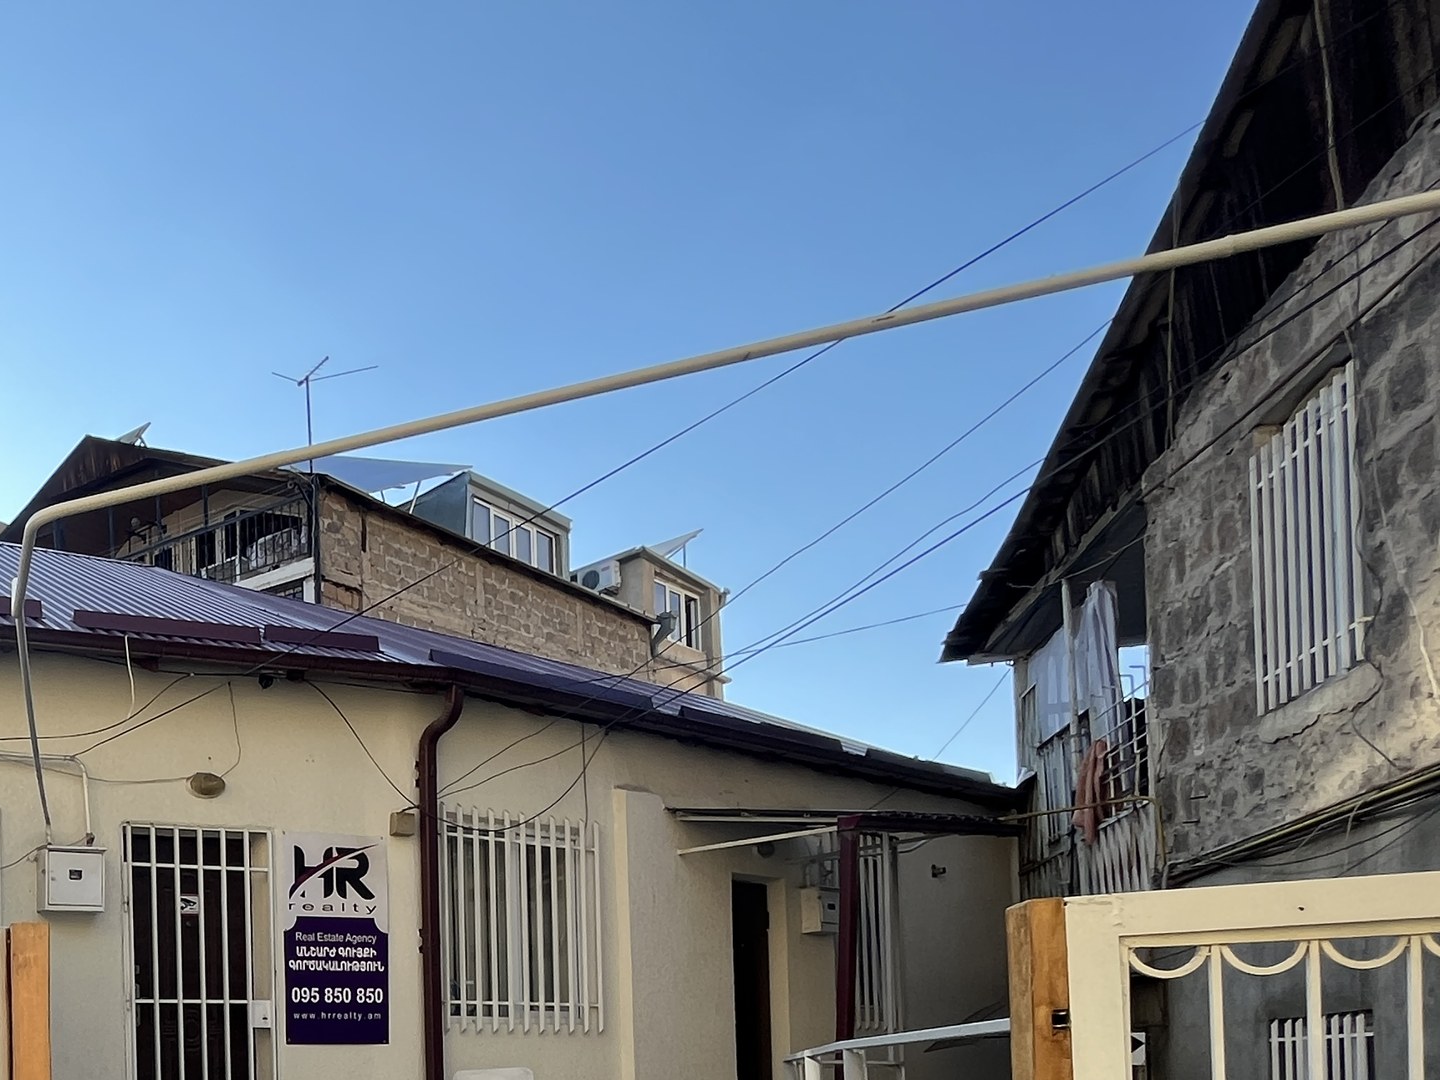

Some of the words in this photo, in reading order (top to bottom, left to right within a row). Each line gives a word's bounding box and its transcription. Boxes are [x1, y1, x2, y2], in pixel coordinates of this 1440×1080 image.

[289, 845, 378, 900] HR
[288, 902, 377, 915] realty
[295, 931, 315, 942] Real
[316, 932, 344, 943] Estate
[345, 933, 377, 945] Agency
[296, 945, 337, 958] ԱՆՇԱՐԺ
[338, 946, 377, 958] ԳՈՒՅՔԻ
[291, 986, 320, 1003] 095
[324, 987, 352, 1004] 850
[356, 987, 384, 1004] 850
[293, 1011, 382, 1022] www.hrrealty.am
